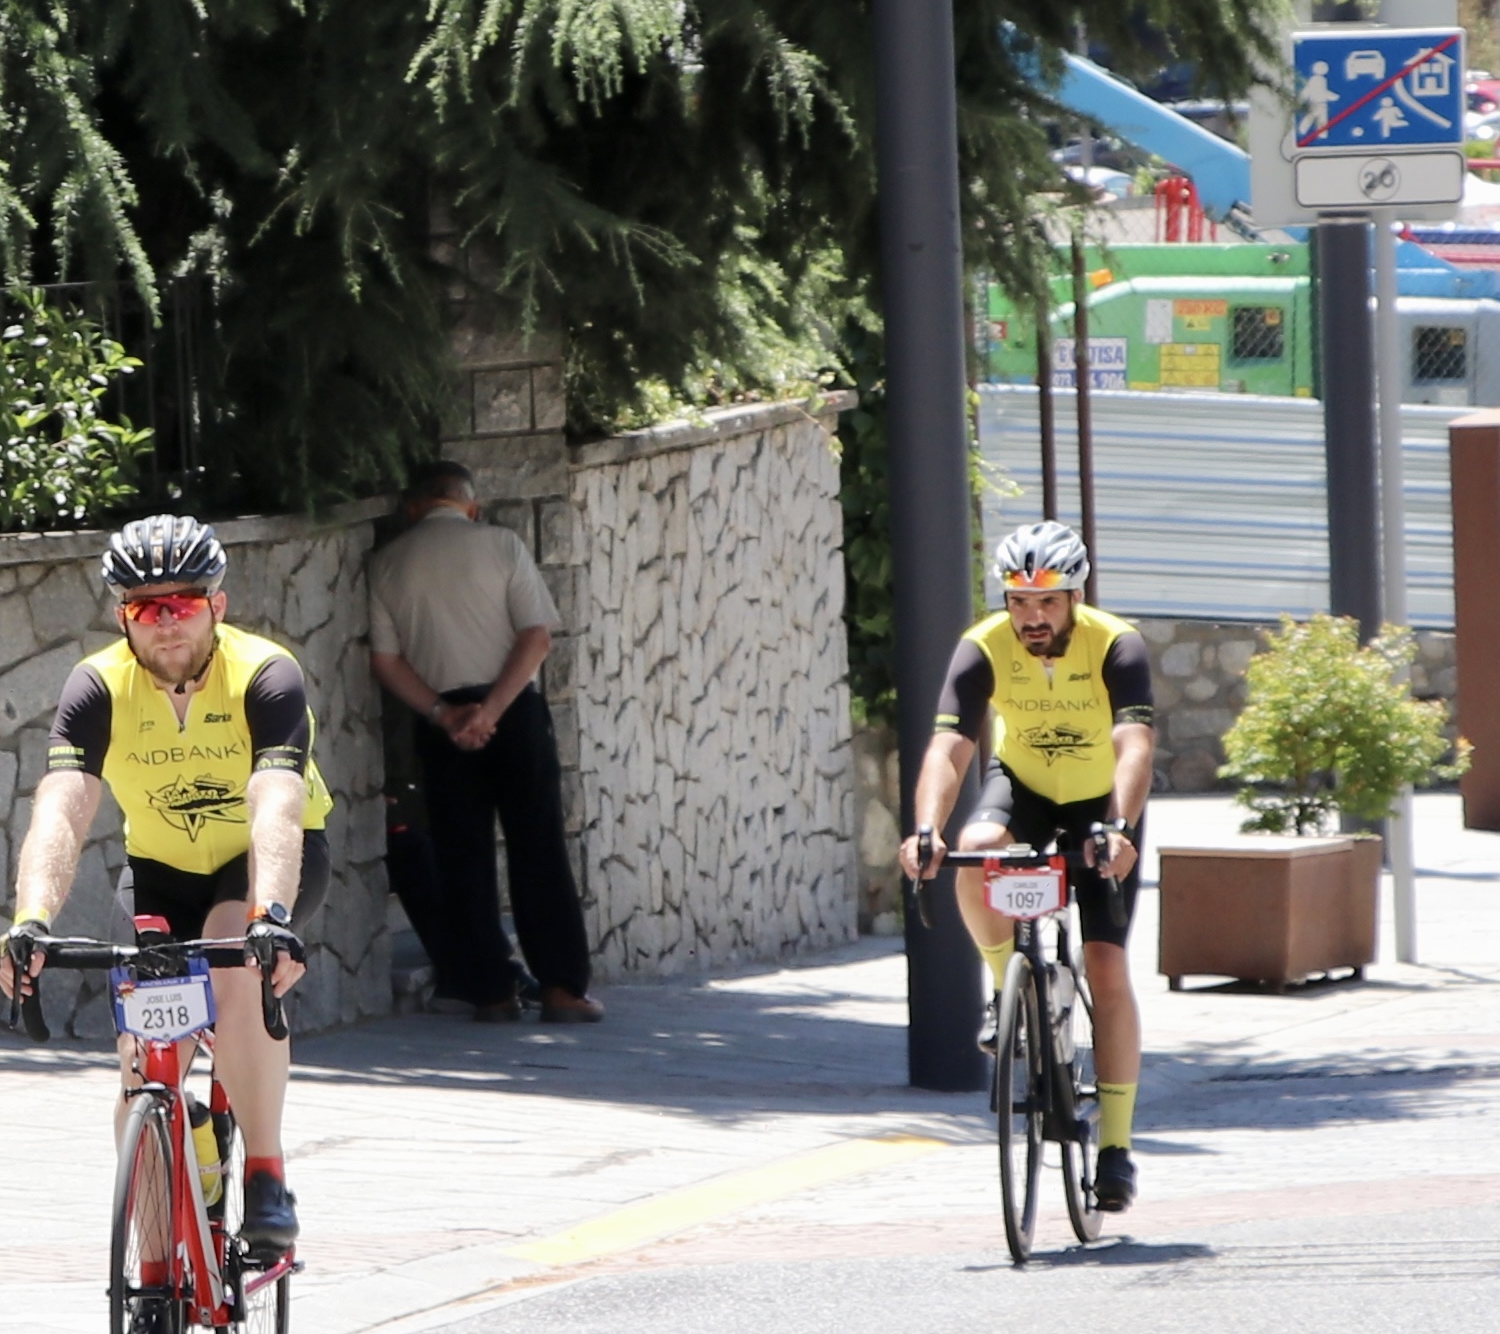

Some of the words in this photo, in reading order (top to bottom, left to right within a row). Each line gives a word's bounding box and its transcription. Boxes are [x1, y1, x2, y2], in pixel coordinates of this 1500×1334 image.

[1006, 892, 1045, 909] 1097
[146, 995, 165, 1005] JOSE
[141, 1005, 190, 1029] 2318
